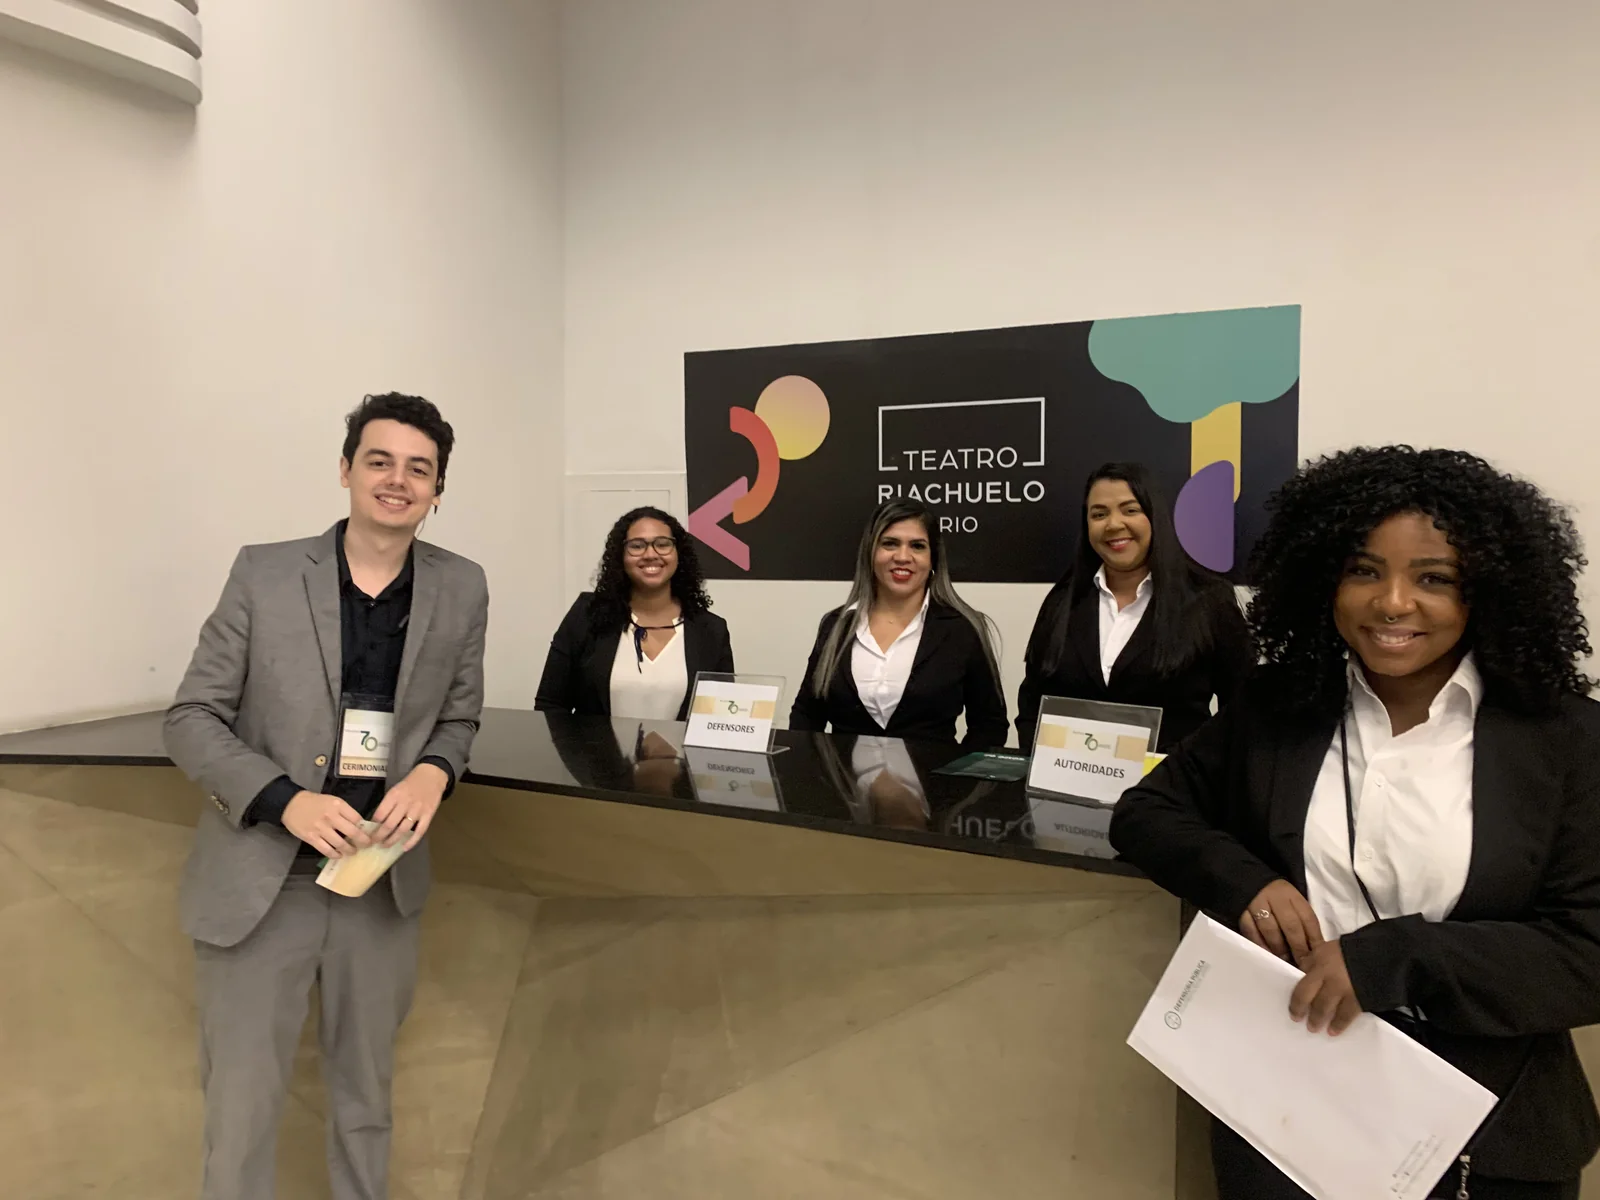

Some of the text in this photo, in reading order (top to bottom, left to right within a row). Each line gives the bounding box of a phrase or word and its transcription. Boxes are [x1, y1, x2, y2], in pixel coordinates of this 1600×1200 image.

[903, 446, 1018, 471] TEATRO
[878, 480, 1045, 505] RIACHUELO
[939, 516, 979, 533] RIO
[707, 721, 756, 734] DEFENSORES
[360, 730, 378, 752] 70
[1084, 732, 1098, 751] 70
[1054, 757, 1125, 779] AUTORIDADES
